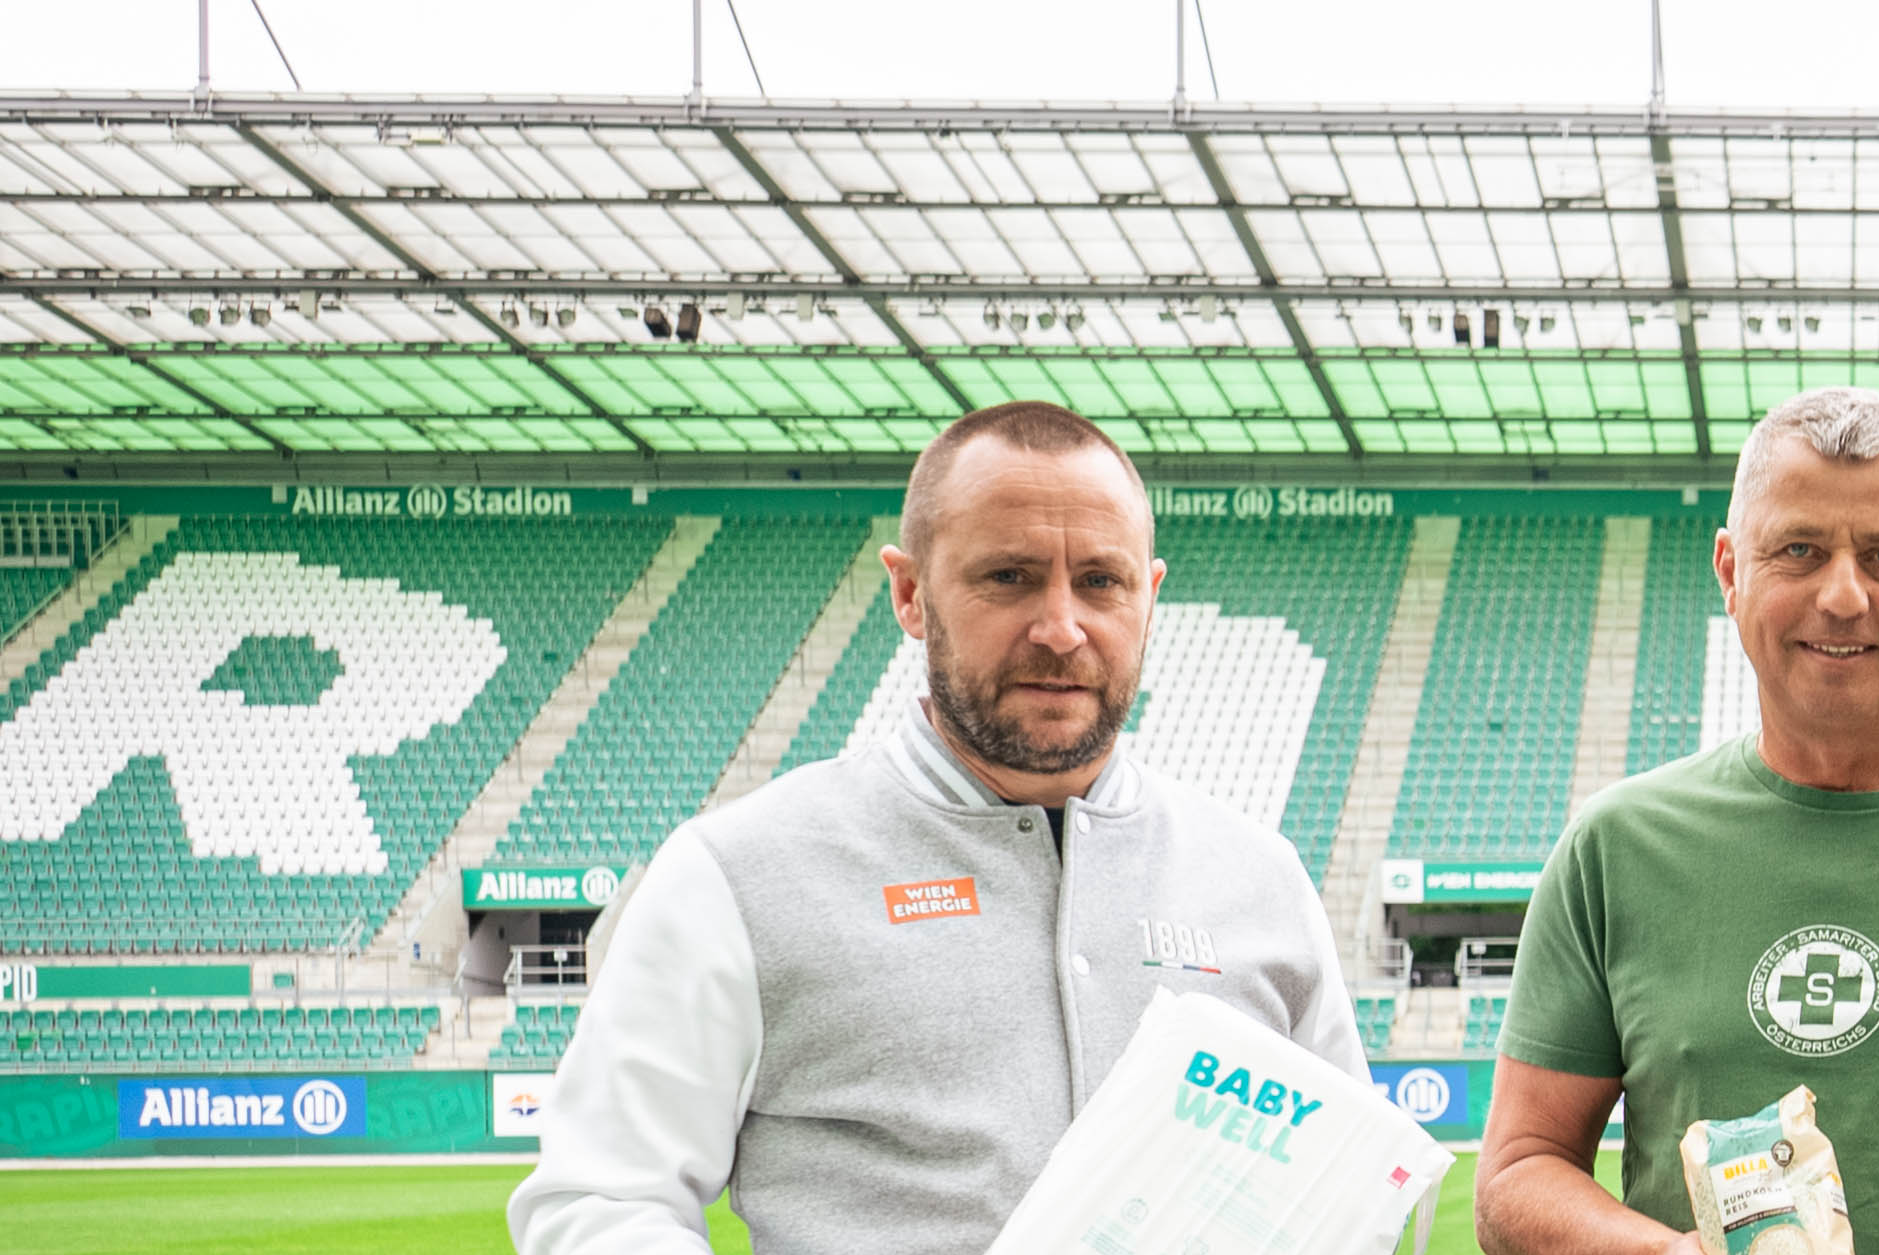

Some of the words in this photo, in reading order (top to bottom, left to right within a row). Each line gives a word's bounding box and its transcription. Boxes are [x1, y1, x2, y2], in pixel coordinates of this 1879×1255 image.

[292, 487, 400, 515] Allianz
[453, 487, 572, 515] Stadion
[1148, 488, 1228, 516] lianz
[1278, 487, 1395, 516] Stadion
[476, 872, 578, 901] Allianz
[905, 884, 955, 900] WIEN
[893, 897, 972, 918] ENERGIE
[1138, 919, 1217, 964] 1899
[1805, 972, 1835, 1006] S
[1183, 1050, 1323, 1128] BABY
[139, 1087, 285, 1128] Allianz
[1172, 1084, 1292, 1164] WELL
[1724, 1158, 1768, 1180] BILLA
